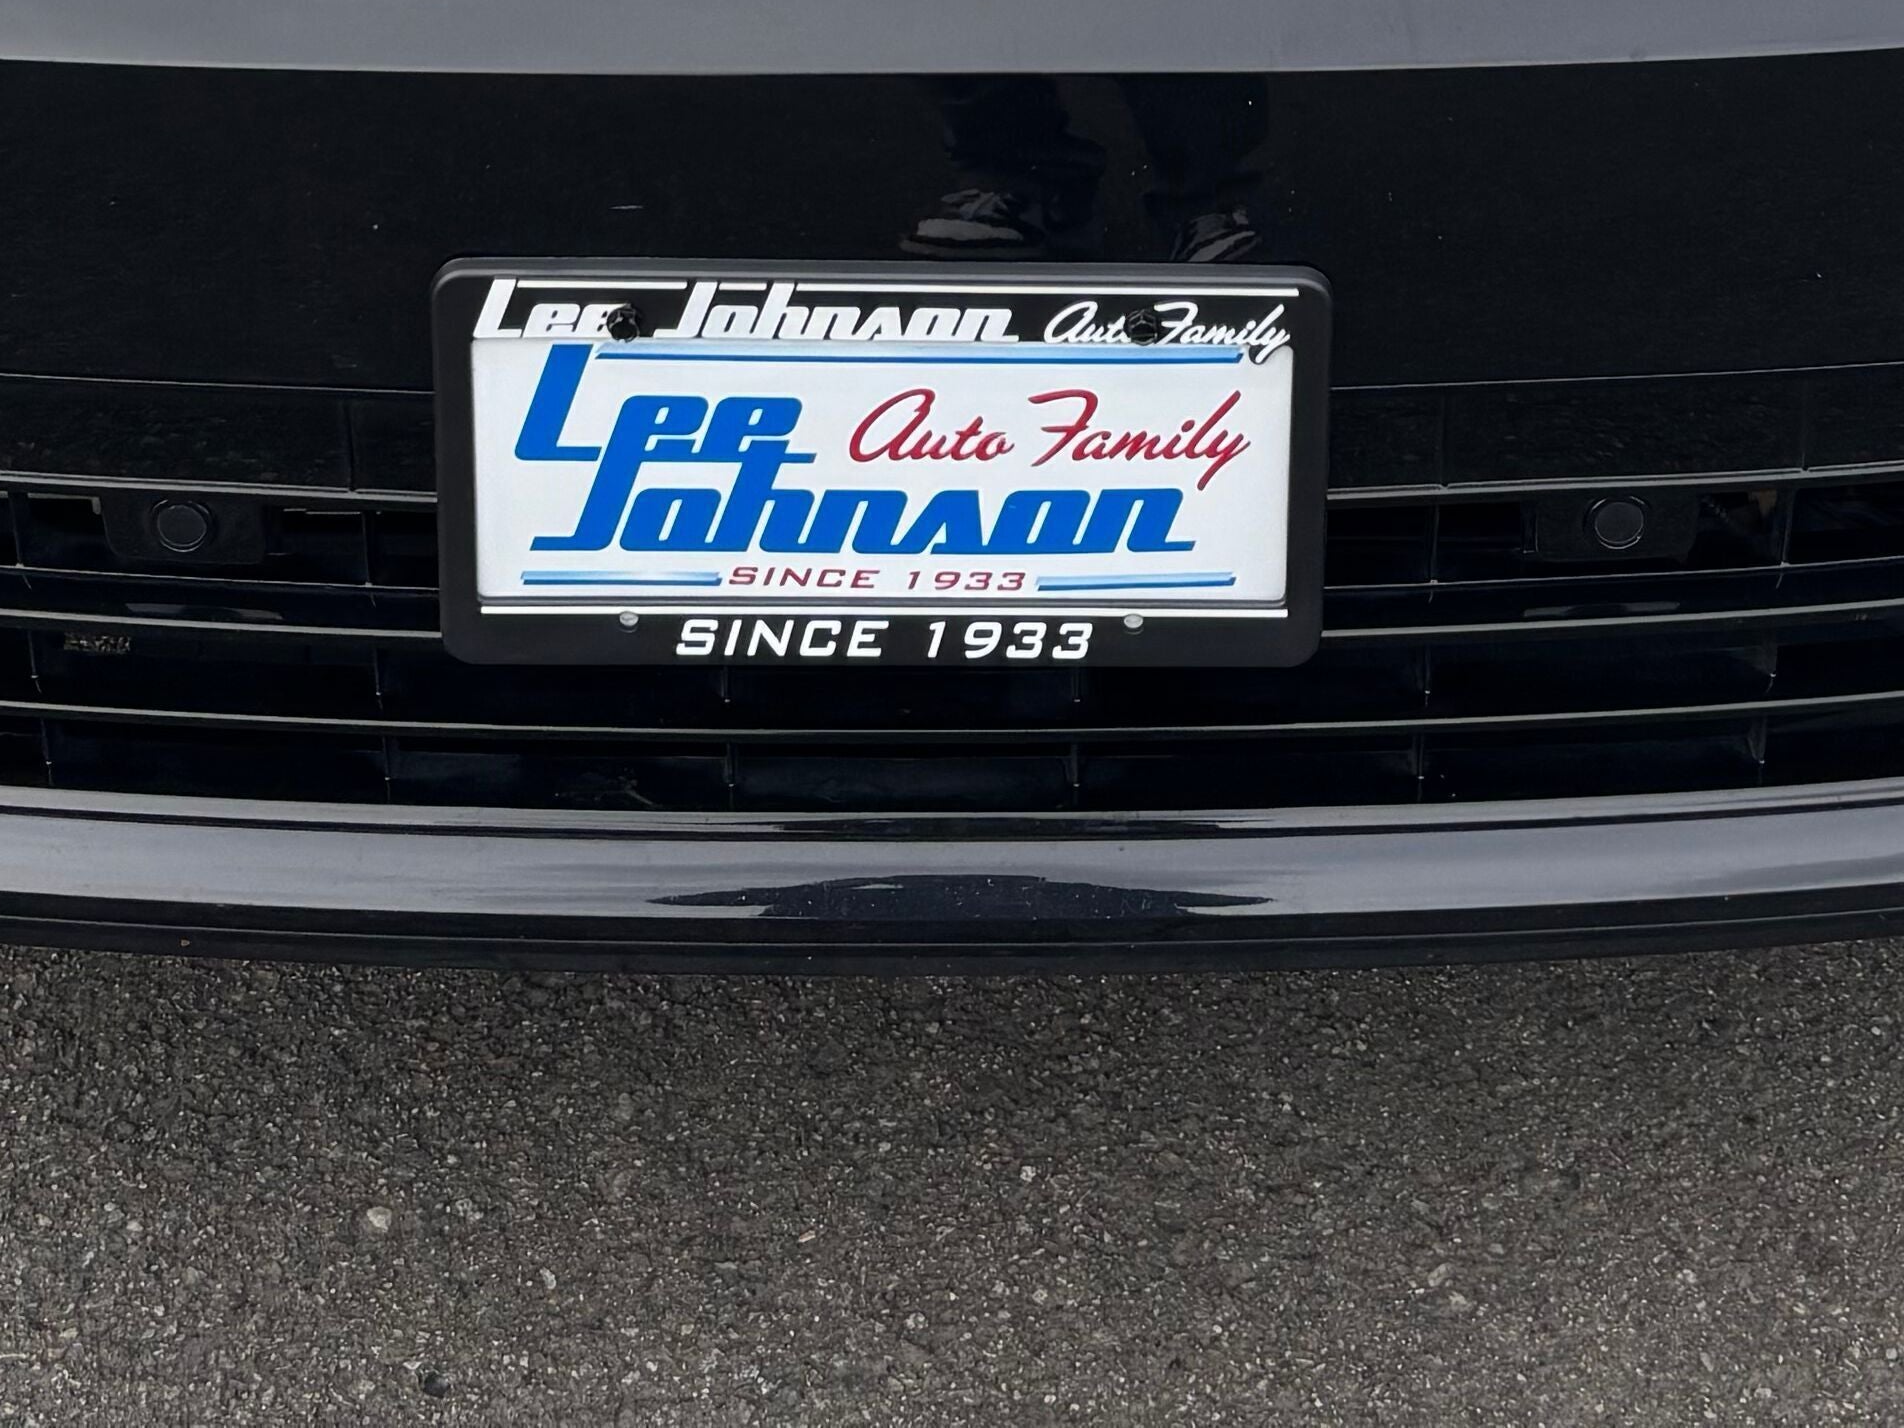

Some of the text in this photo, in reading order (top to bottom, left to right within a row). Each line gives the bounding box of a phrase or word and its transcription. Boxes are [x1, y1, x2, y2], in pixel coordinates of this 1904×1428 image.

[652, 280, 1020, 343] Johnson
[1043, 300, 1133, 344] Aut
[1153, 301, 1291, 364] Family
[514, 343, 1251, 491] Lee Auto Family
[529, 455, 1196, 554] Johnson
[728, 566, 1027, 592] SINCE 1933
[675, 618, 1094, 660] SINCE 1933
